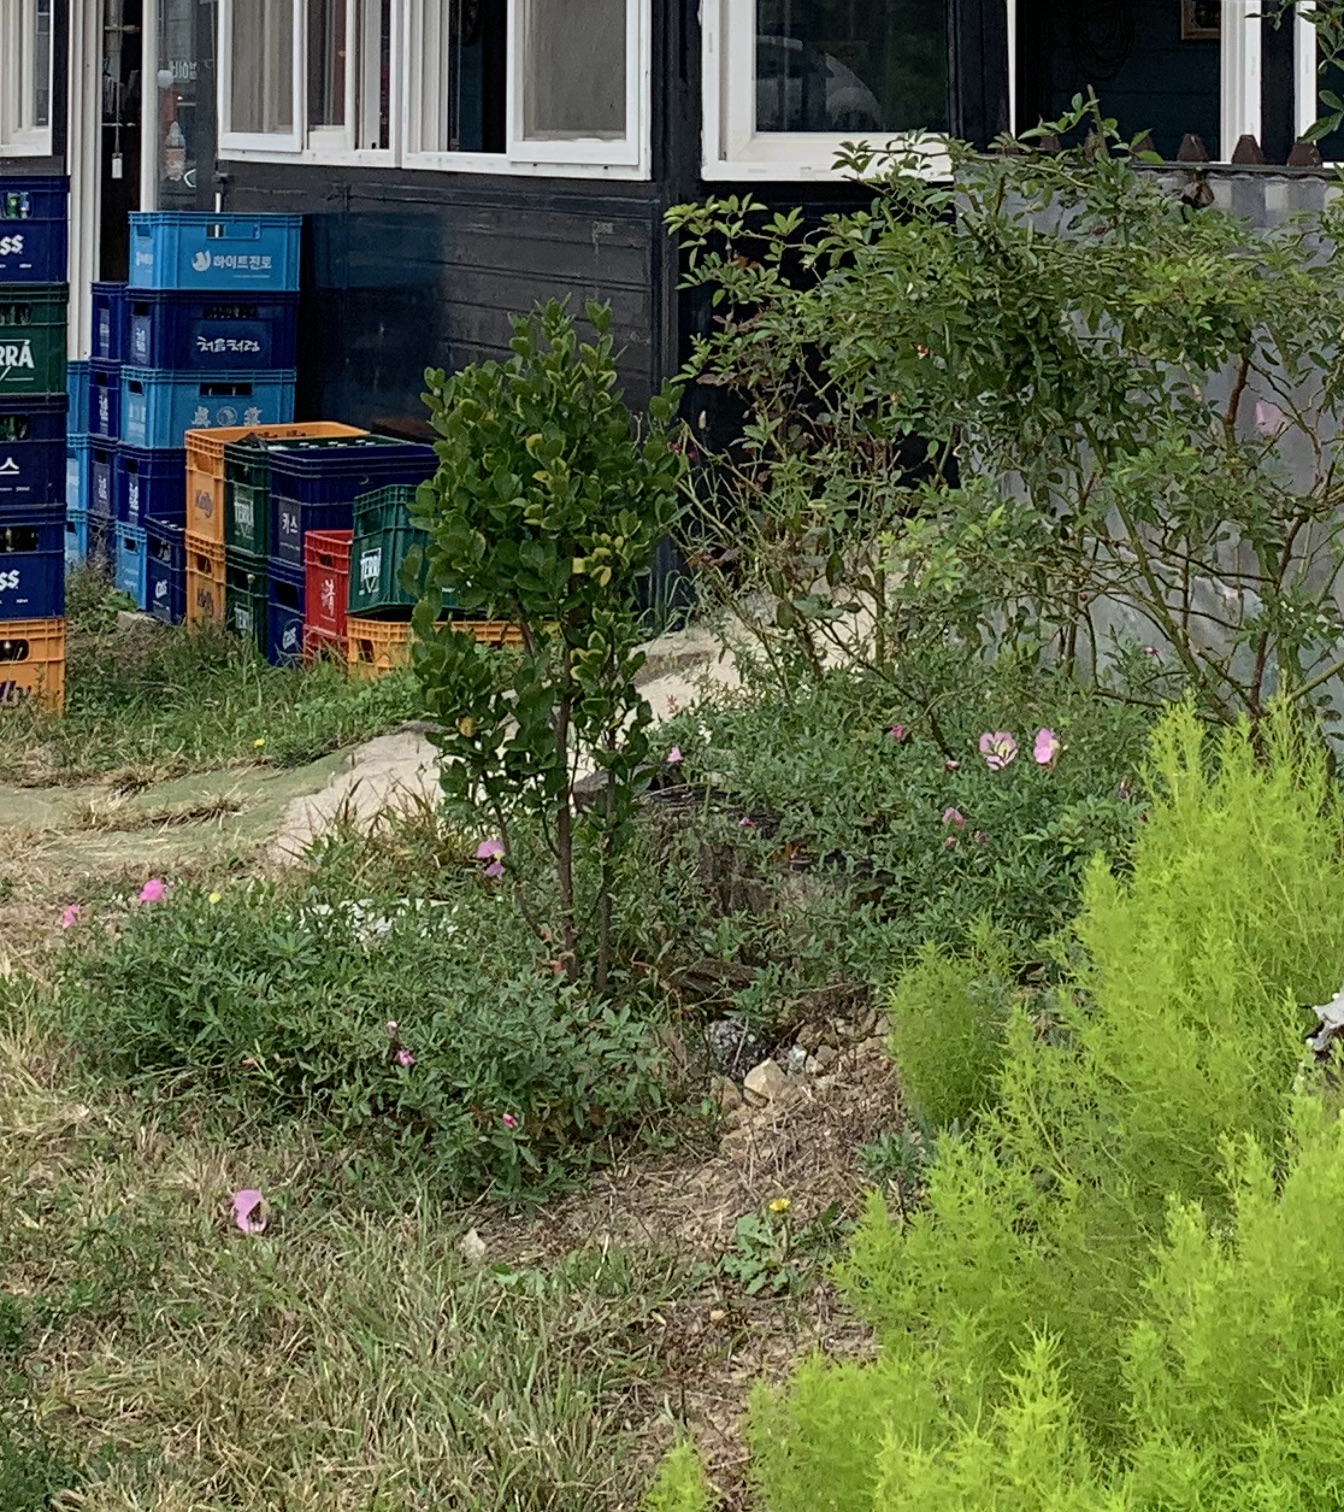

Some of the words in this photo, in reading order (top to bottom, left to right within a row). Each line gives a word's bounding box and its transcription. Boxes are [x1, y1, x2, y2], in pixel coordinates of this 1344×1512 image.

[212, 254, 272, 270] 하이트진로
[196, 335, 261, 353] 처음처럼
[282, 511, 299, 535] 카스
